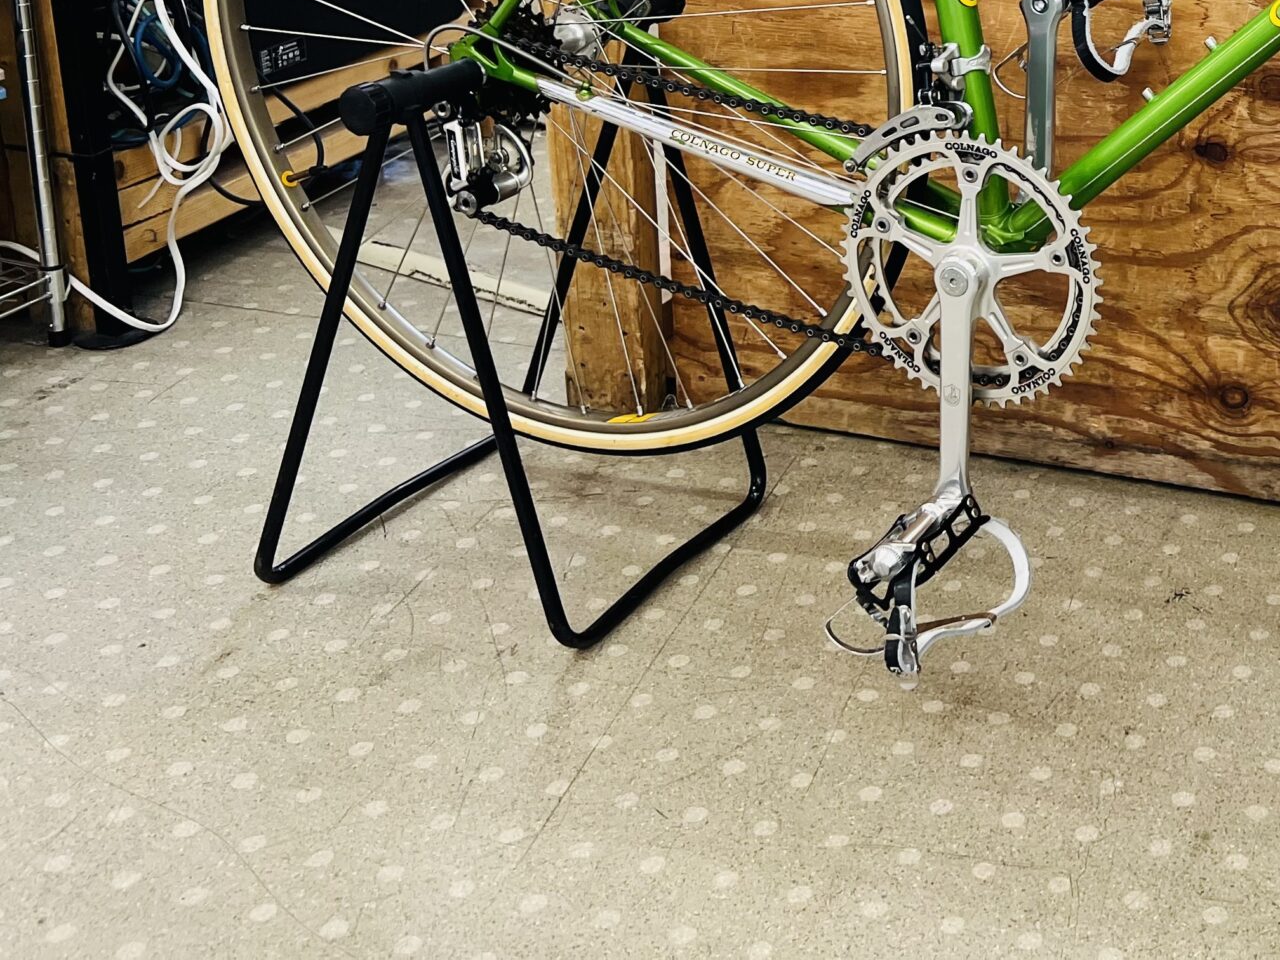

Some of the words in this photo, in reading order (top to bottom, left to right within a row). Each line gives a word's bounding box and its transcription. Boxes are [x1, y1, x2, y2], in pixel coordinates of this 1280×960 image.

[671, 129, 741, 161] COLNAGO
[745, 155, 798, 182] SUPER
[945, 142, 998, 159] COLNAGO
[850, 189, 872, 238] COLNAGO
[1070, 228, 1091, 285] COLNAGO
[879, 331, 921, 373] COLNAGO
[1011, 368, 1056, 395] COLNAGO
